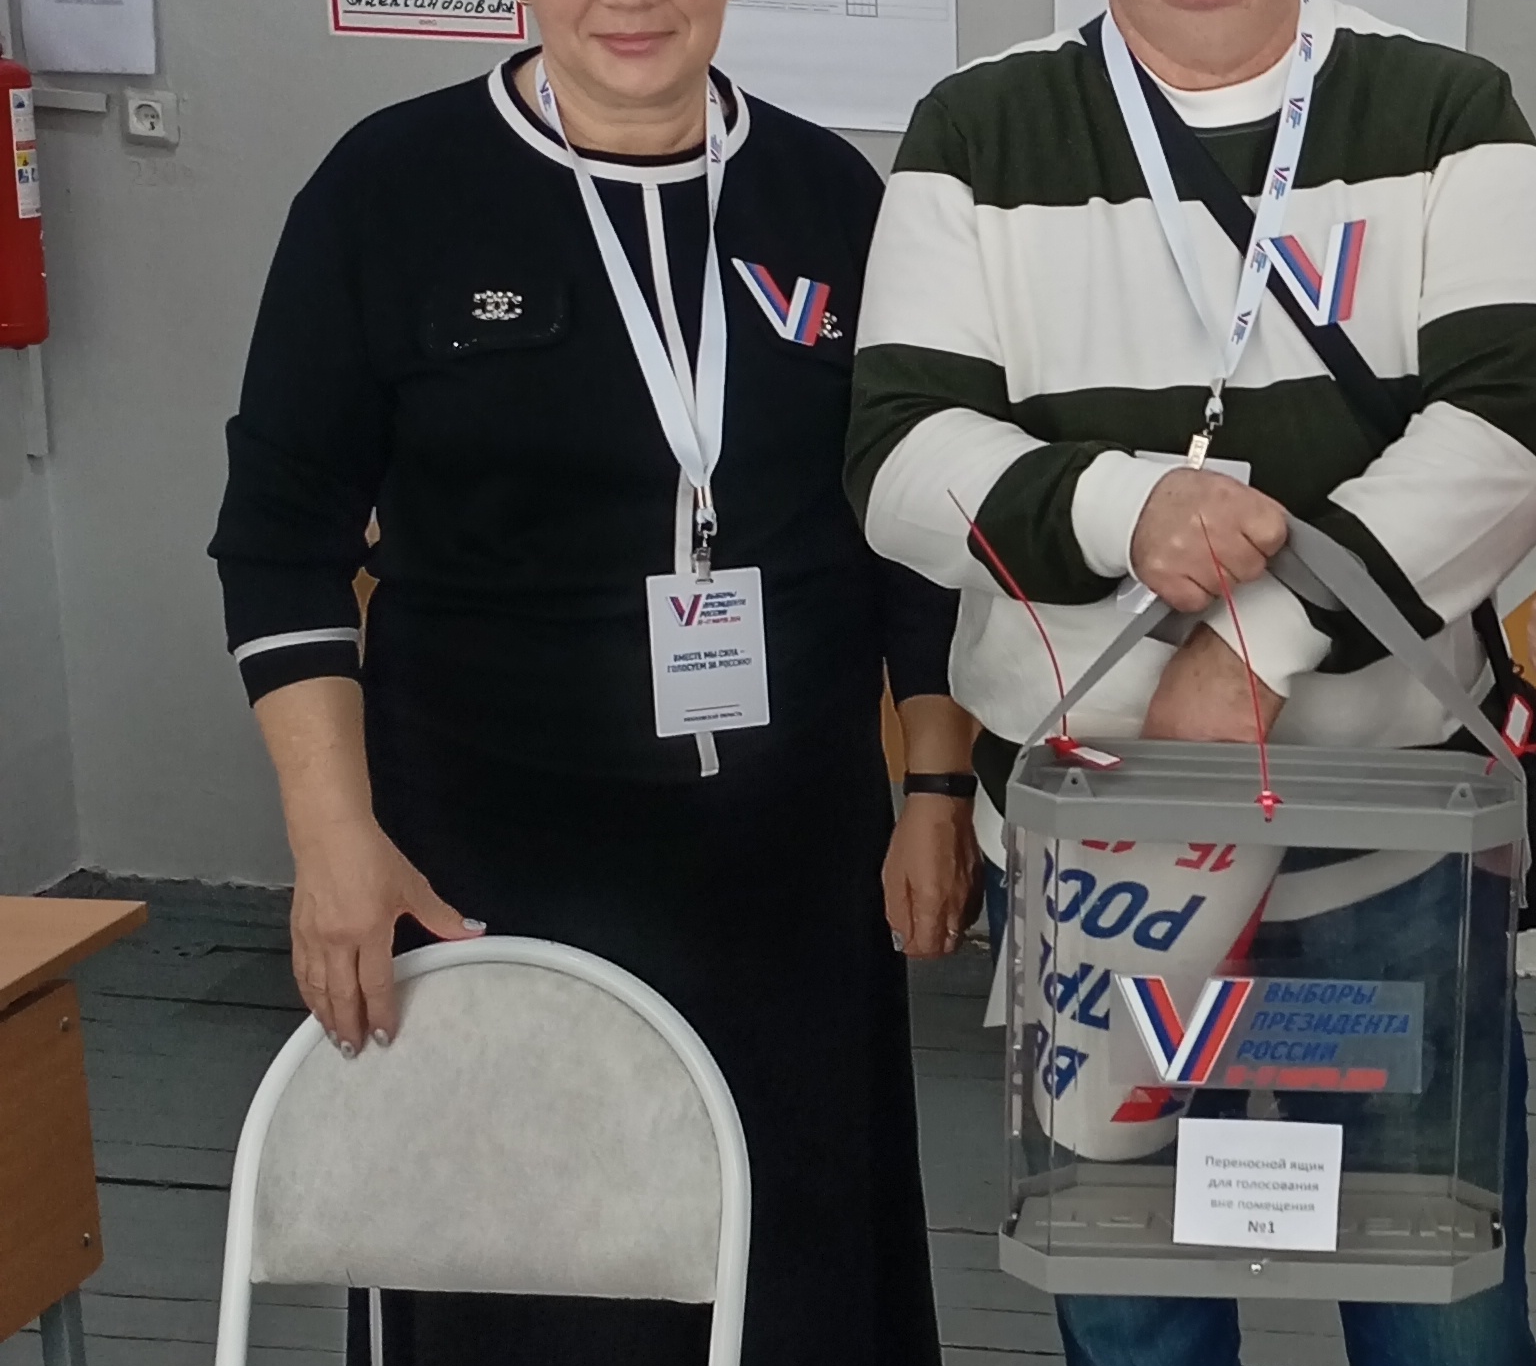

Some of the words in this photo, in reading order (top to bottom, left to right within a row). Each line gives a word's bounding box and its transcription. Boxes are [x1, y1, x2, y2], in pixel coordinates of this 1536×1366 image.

[1263, 981, 1379, 1005] ВЫБОРЫ
[1250, 1010, 1410, 1035] ПРЕЗИДЕНТА
[1236, 1039, 1340, 1062] РОССИИ
[1204, 1155, 1287, 1170] Переносной
[1289, 1161, 1325, 1172] ящик
[1207, 1178, 1233, 1190] для
[1236, 1179, 1319, 1192] голосования
[1210, 1199, 1234, 1209] вне
[1237, 1200, 1316, 1213] помещения
[1247, 1220, 1276, 1234] №1
